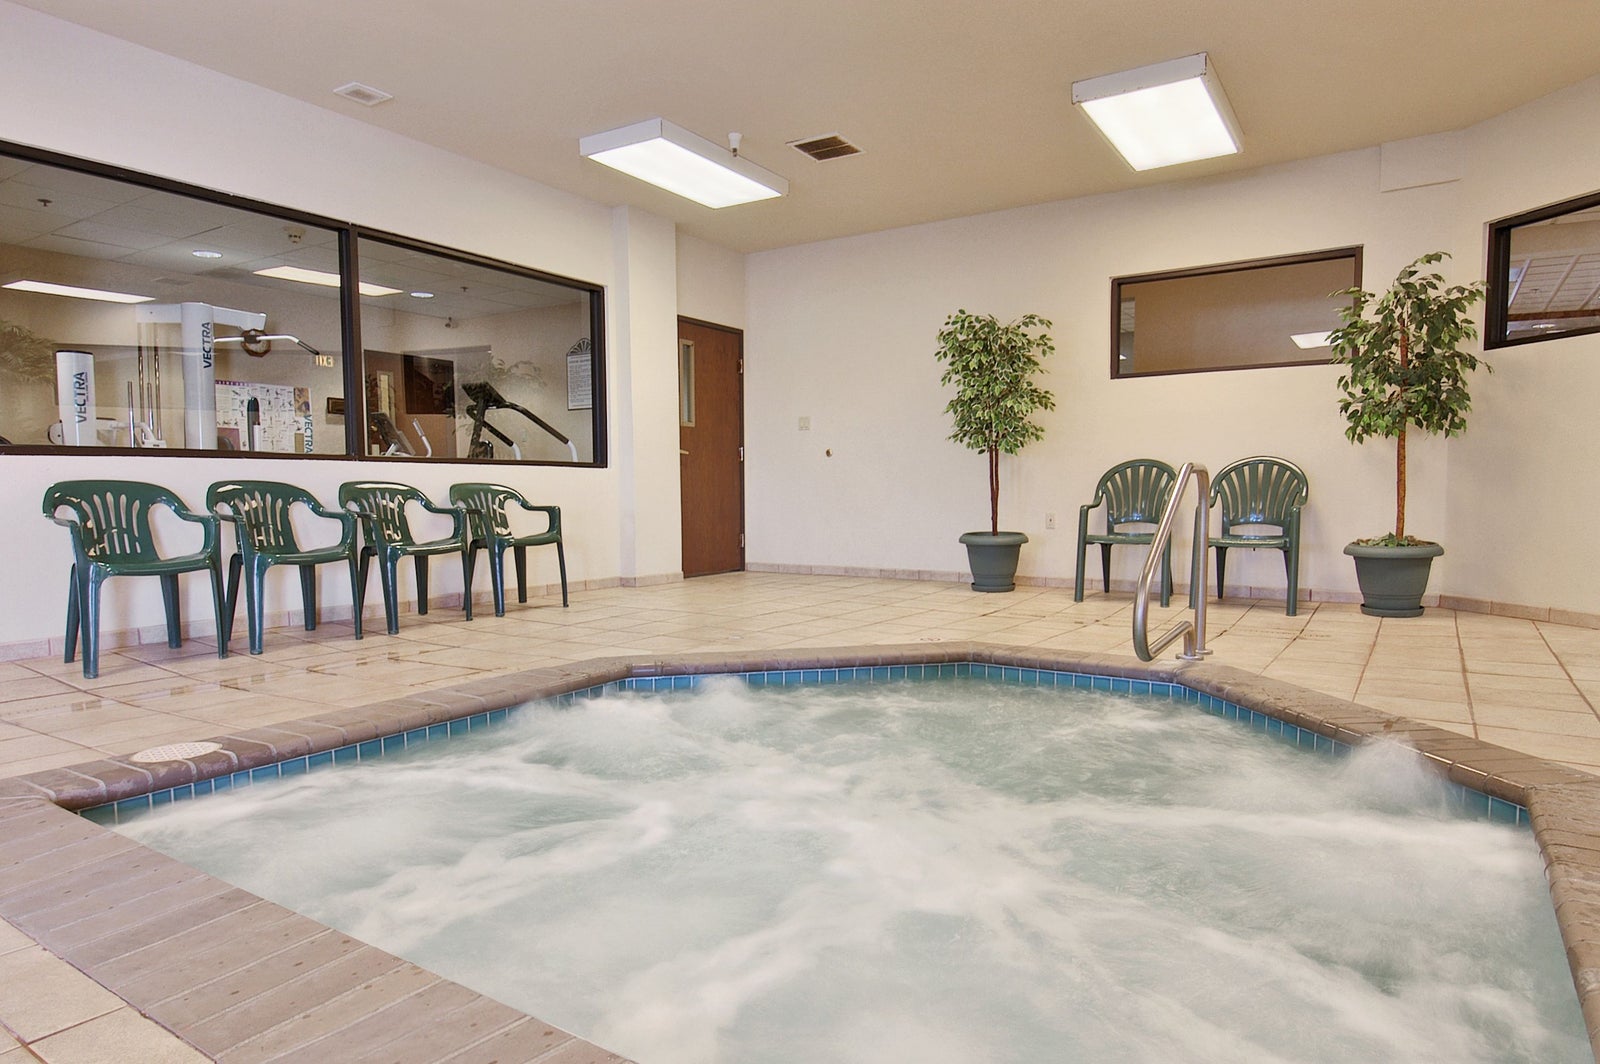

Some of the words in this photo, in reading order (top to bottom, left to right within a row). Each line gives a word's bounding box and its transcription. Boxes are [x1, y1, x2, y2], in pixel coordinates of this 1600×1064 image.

[201, 322, 212, 369] VECTRA
[73, 371, 87, 423] VECTRA
[304, 414, 313, 453] VECTRA
